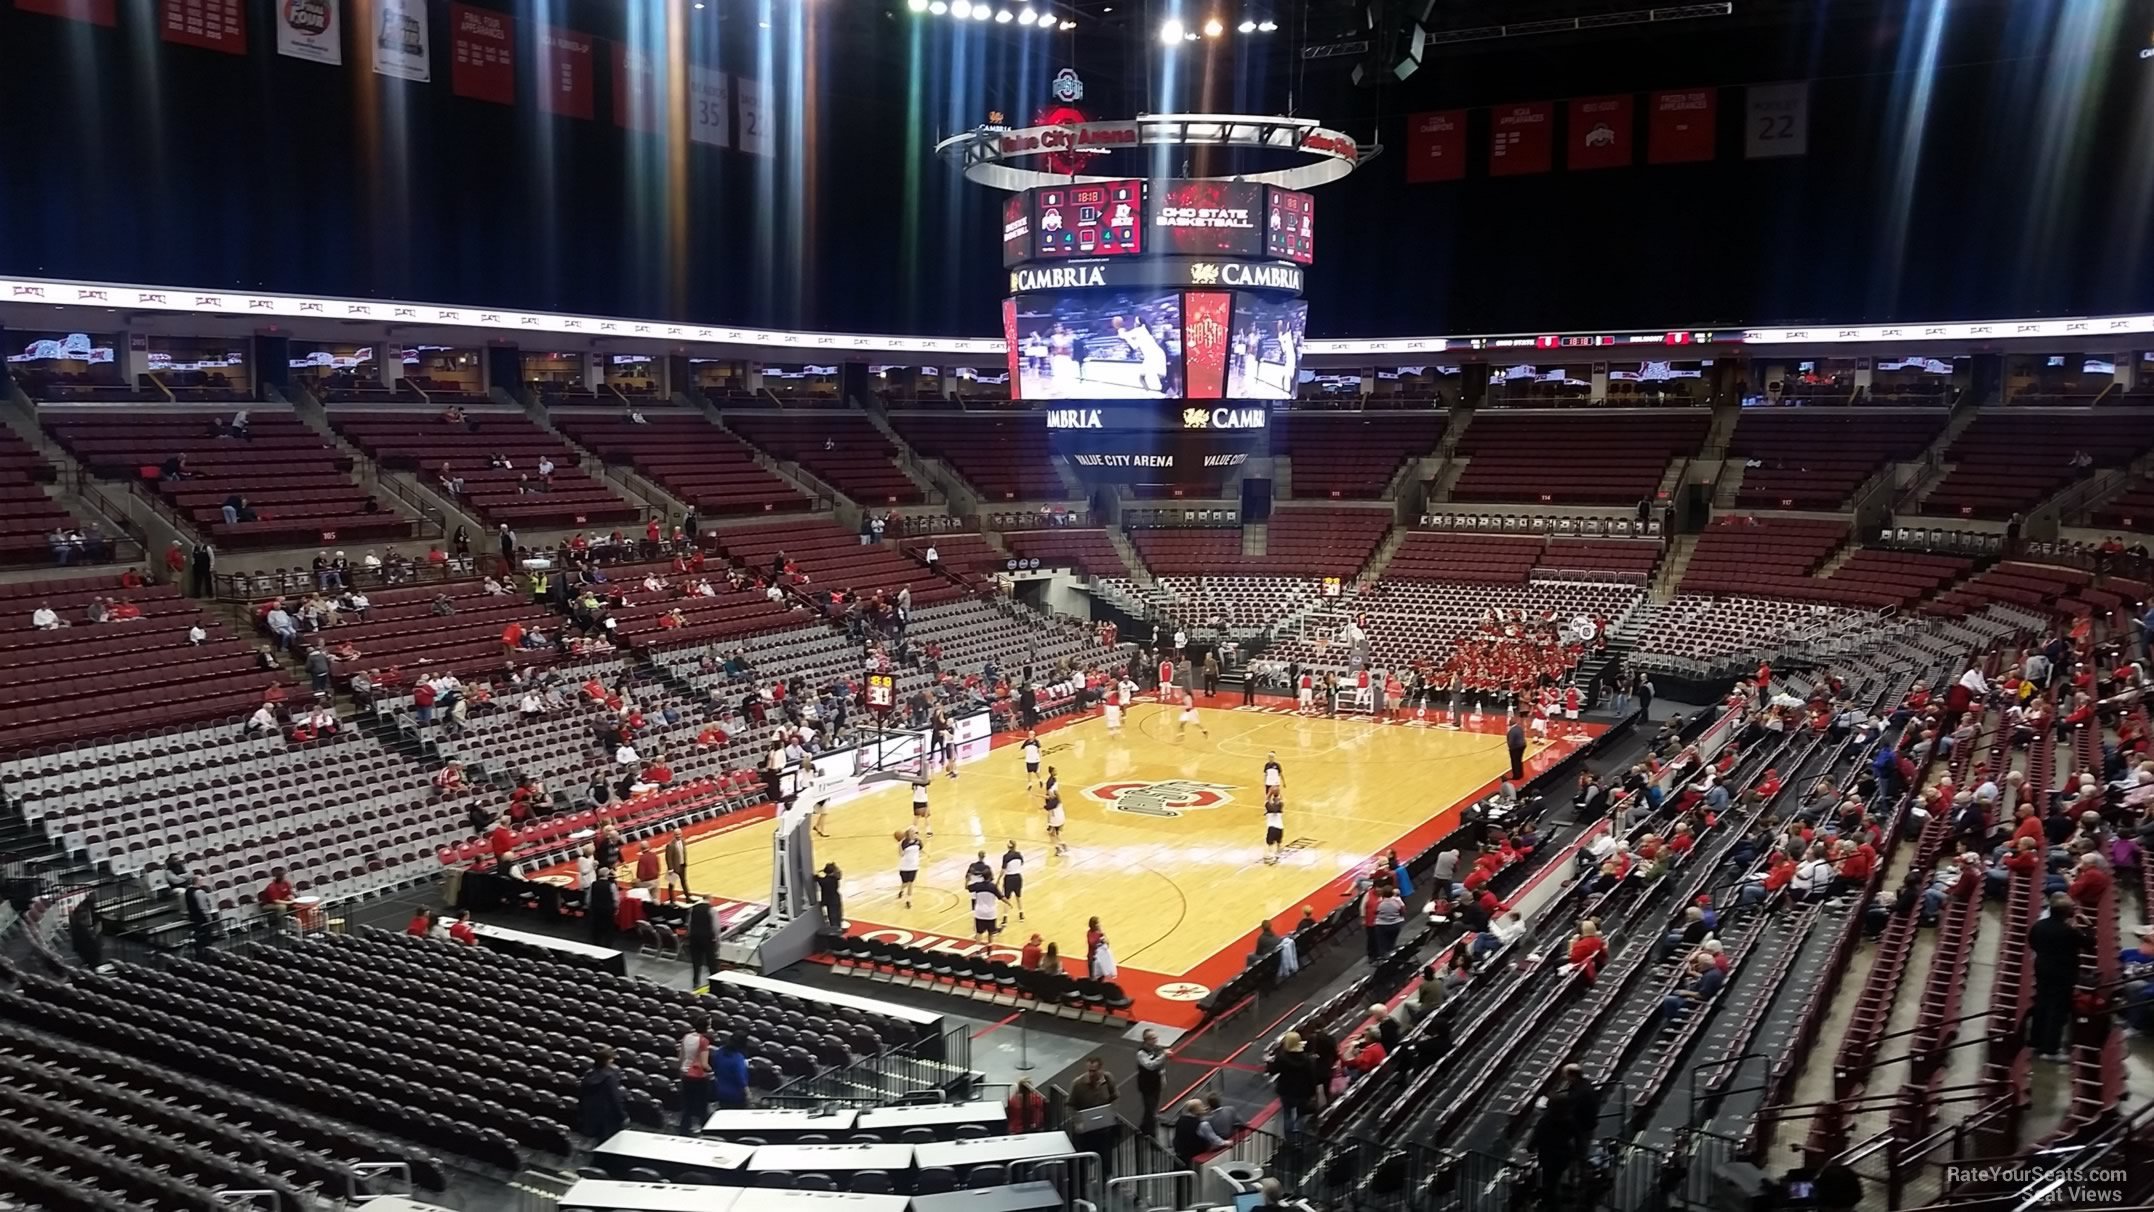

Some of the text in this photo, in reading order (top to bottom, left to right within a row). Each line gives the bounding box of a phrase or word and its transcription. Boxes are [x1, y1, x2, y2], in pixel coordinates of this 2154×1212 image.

[290, 10, 325, 28] FOUR
[699, 99, 721, 127] 35
[1758, 115, 1795, 141] 22
[1001, 128, 1136, 152] Value City Arena
[1162, 208, 1249, 219] OHIO STATE
[1156, 217, 1254, 229] BASKETBALL
[1017, 265, 1105, 290] CAMBRIA
[1221, 263, 1299, 290] CAMBRIA
[1075, 454, 1174, 467] VALUE CITY ARENA
[1203, 454, 1230, 467] VALUE
[322, 531, 336, 540] 105
